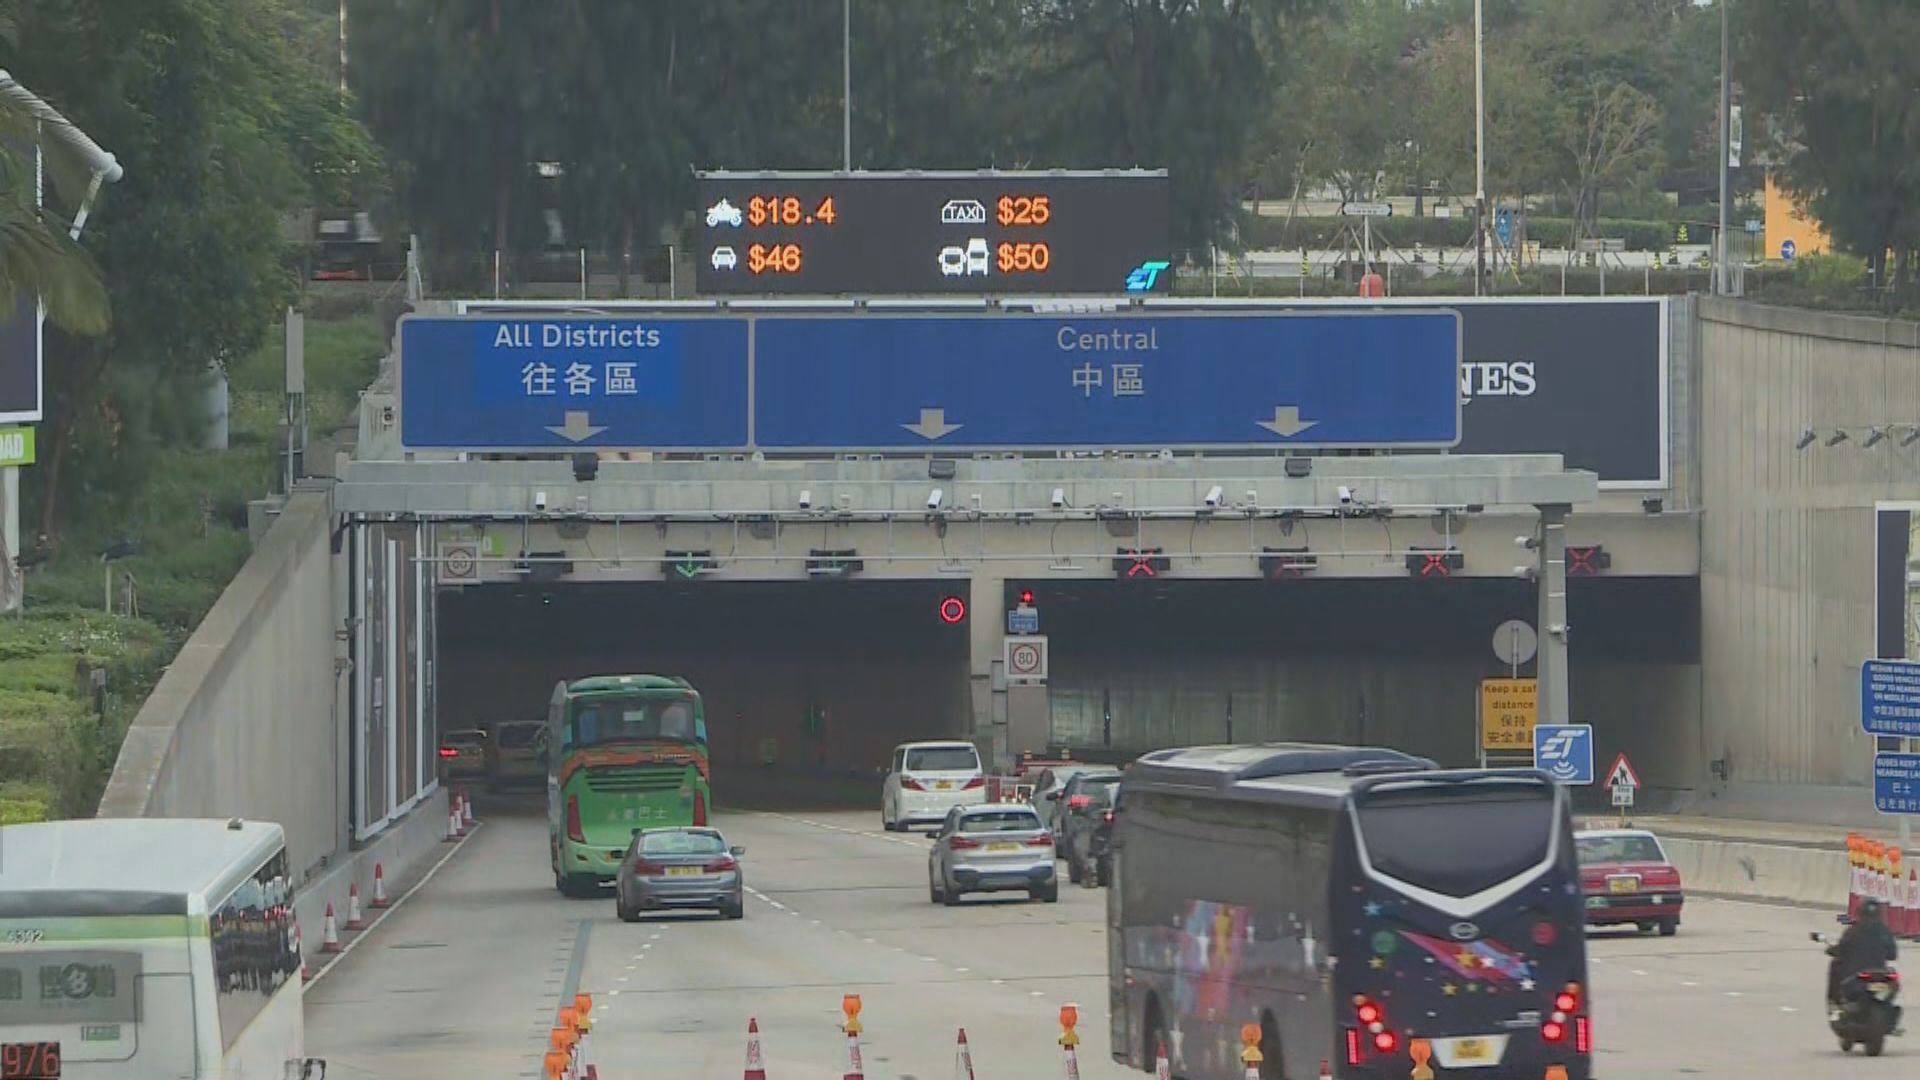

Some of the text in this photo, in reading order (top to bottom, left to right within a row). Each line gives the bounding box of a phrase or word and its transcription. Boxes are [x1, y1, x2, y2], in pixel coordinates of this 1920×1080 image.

[748, 196, 836, 226] $18.4
[947, 196, 1050, 226] TAXI $25
[748, 243, 801, 273] $46
[998, 243, 1050, 273] $50
[494, 324, 661, 348] All Districts
[1057, 325, 1159, 352] Central
[521, 362, 638, 396] 往各區
[1072, 363, 1144, 398] 中區
[1018, 651, 1034, 665] 80
[1485, 684, 1510, 695] Keep
[1521, 684, 1537, 694] saf
[1492, 700, 1534, 709] distance
[1501, 714, 1526, 728] 保持
[3, 1043, 60, 1076] 976
